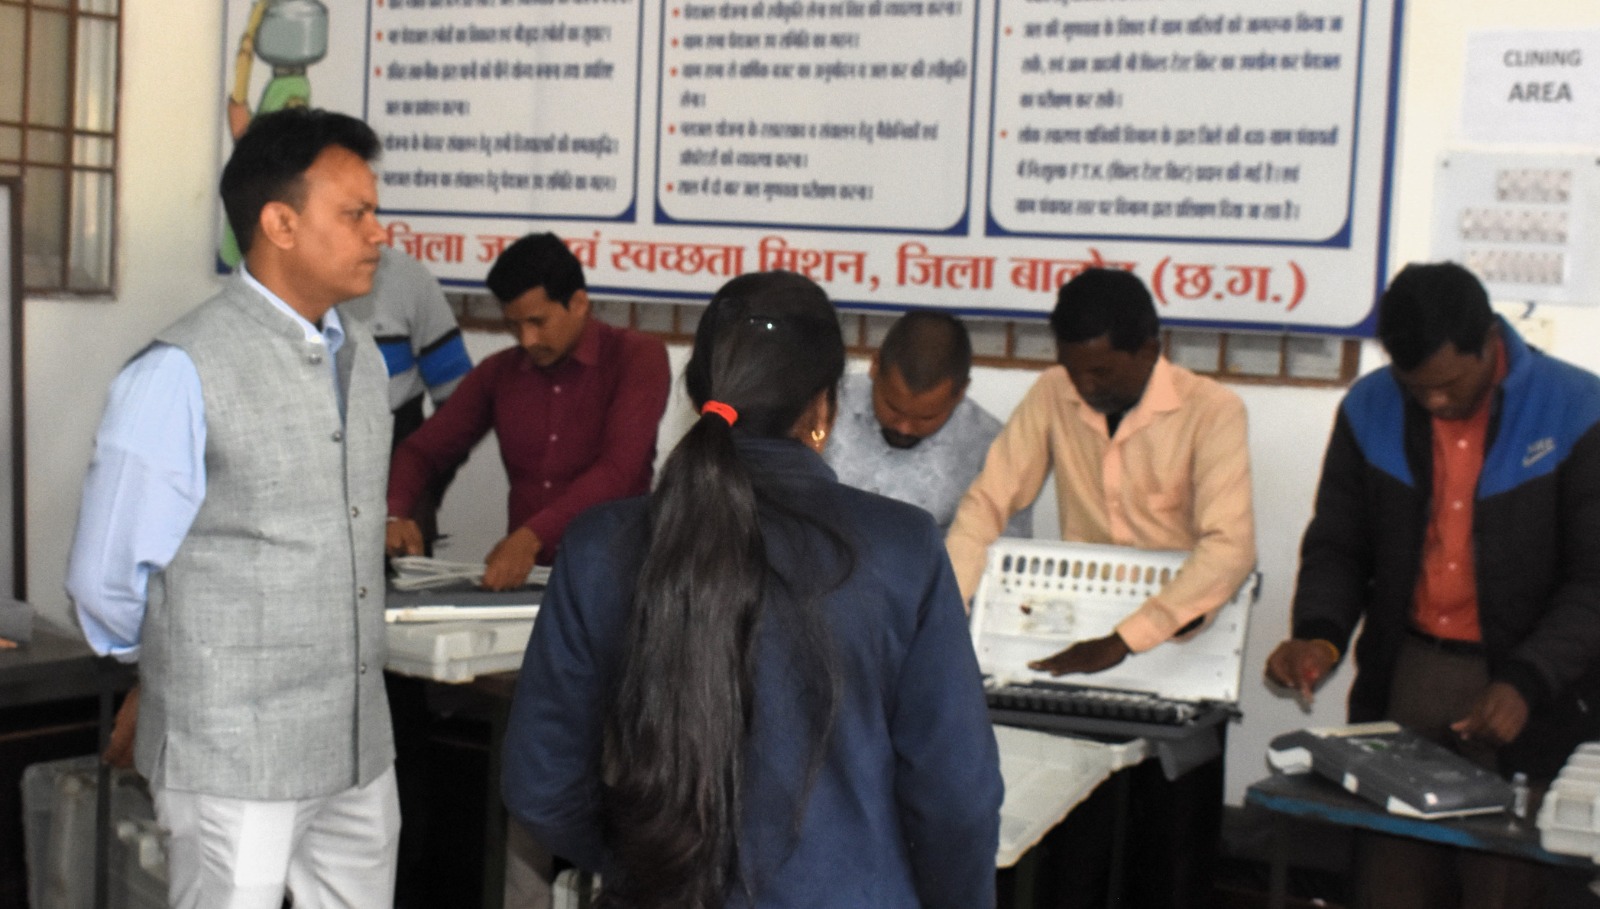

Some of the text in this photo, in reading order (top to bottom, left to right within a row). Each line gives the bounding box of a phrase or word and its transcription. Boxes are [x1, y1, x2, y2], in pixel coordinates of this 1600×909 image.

[1503, 49, 1582, 67] CLINING
[1508, 82, 1572, 103] AREA
[610, 239, 745, 276] स्वच्छता
[758, 235, 881, 291] मिशन,
[896, 241, 997, 289] जिला
[1152, 255, 1307, 312] (छ.ग.)
